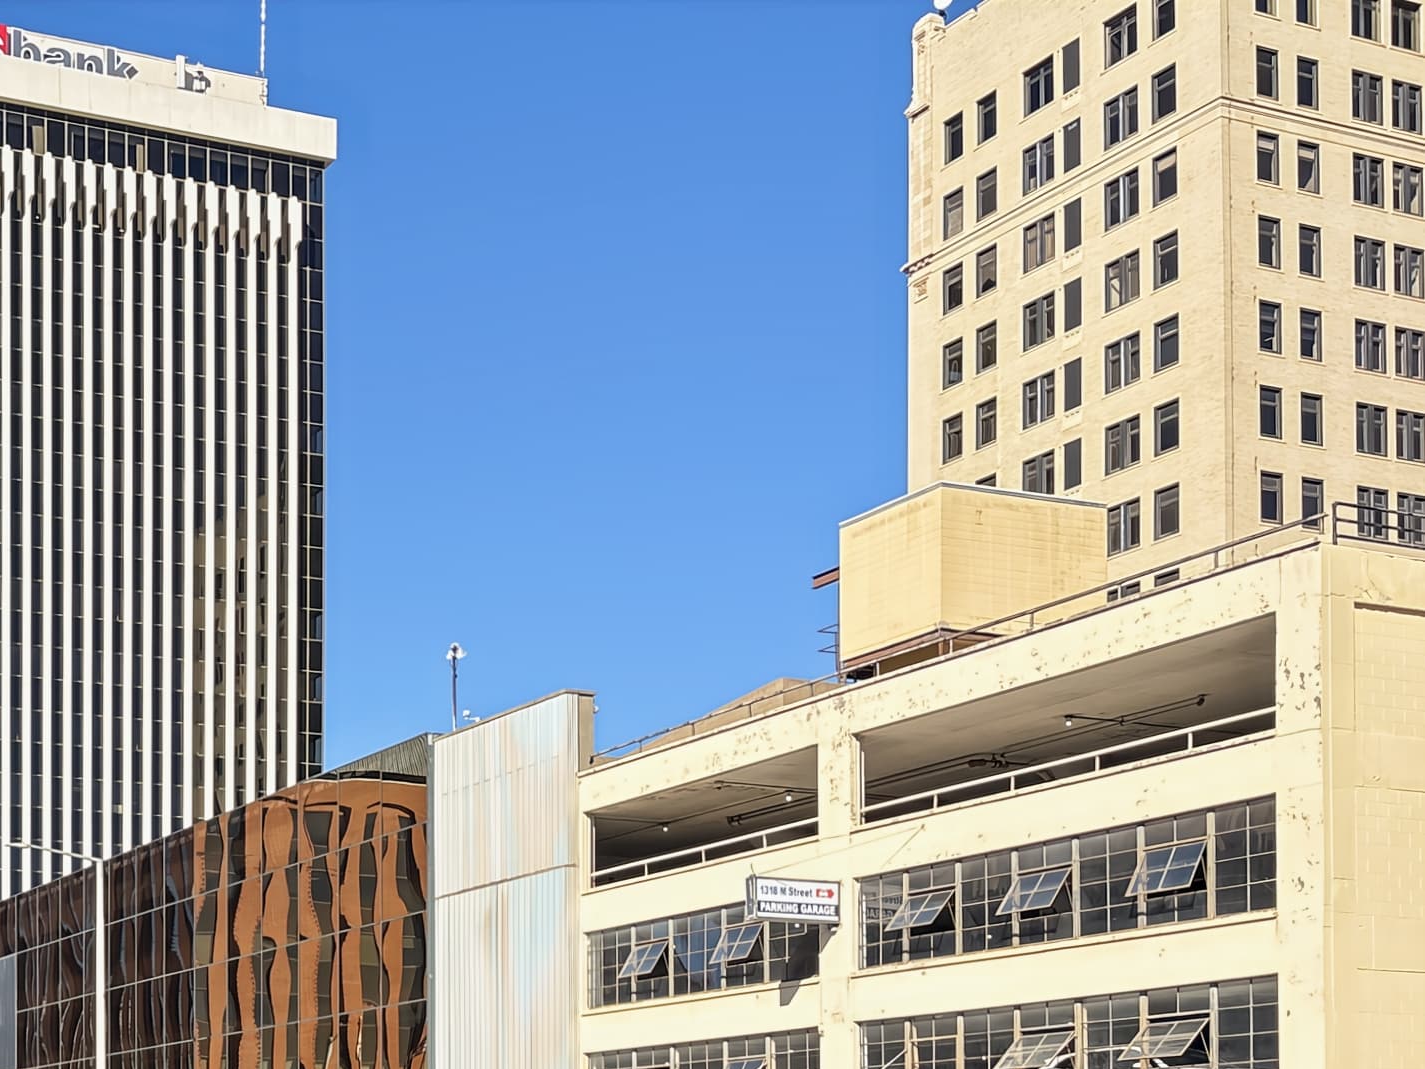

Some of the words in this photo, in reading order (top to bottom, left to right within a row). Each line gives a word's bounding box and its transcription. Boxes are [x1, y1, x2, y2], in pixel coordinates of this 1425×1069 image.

[788, 886, 813, 898] Street
[759, 901, 799, 914] PARKING
[800, 903, 836, 916] GARAGE
